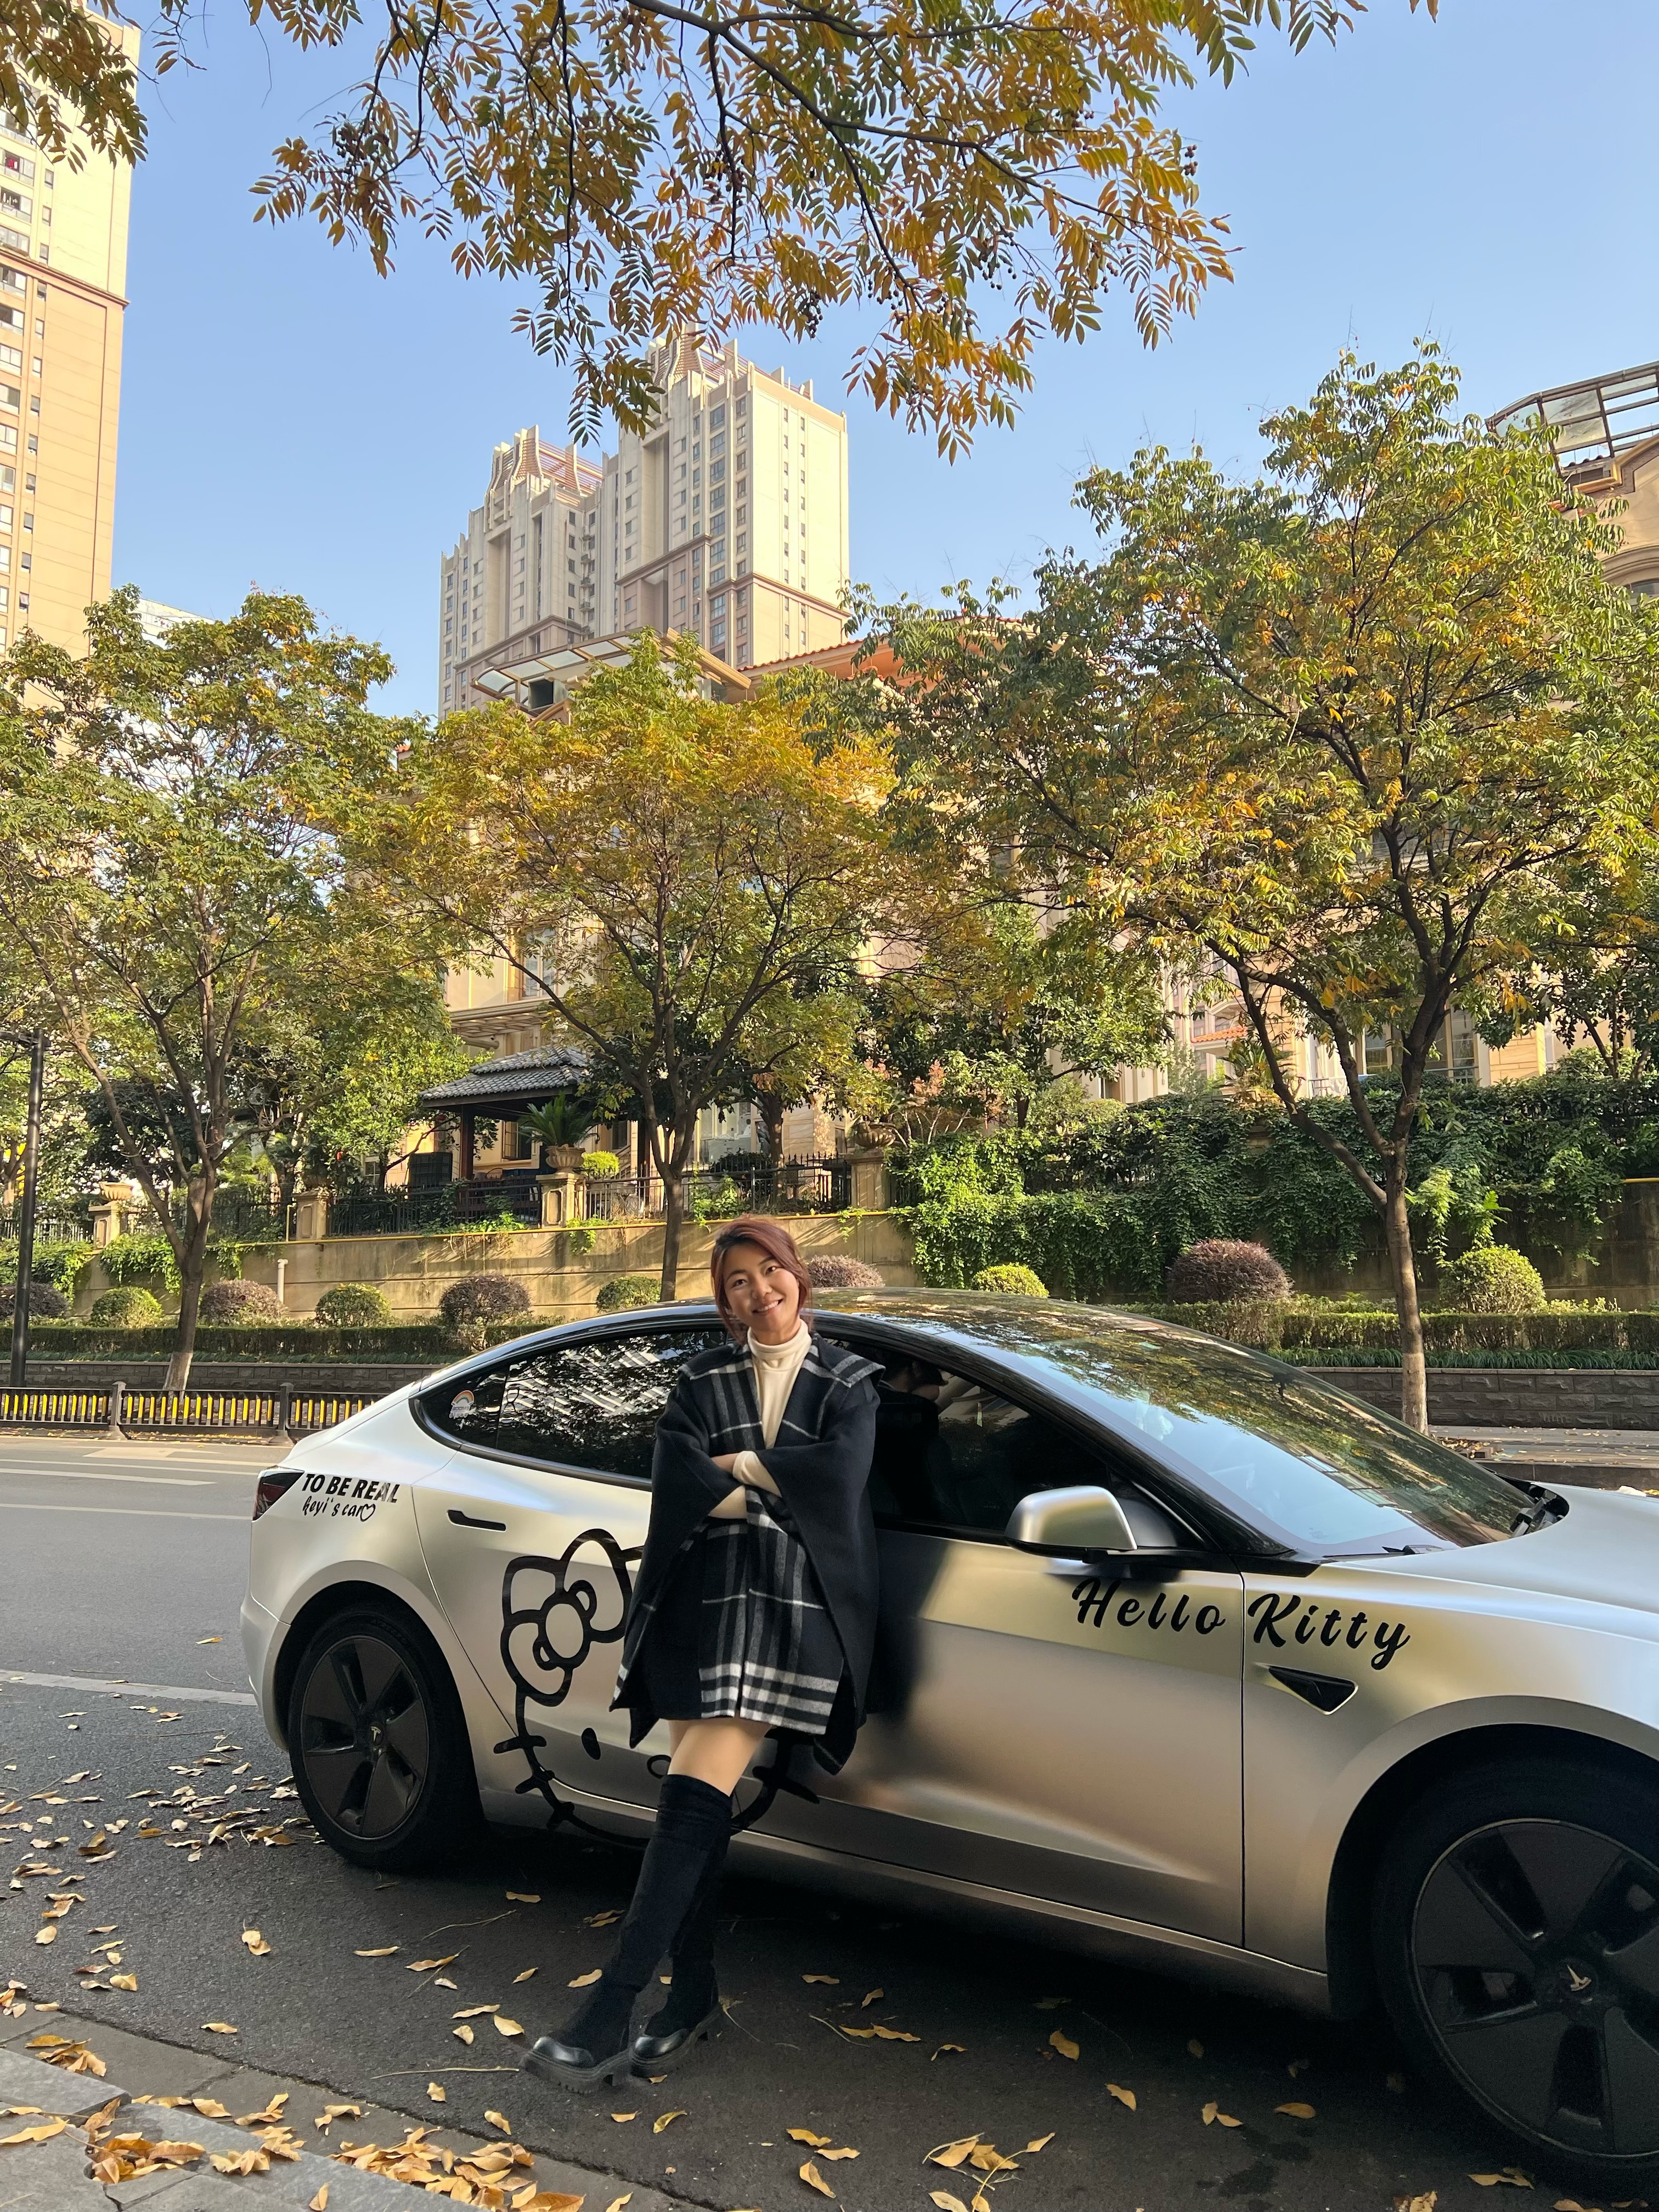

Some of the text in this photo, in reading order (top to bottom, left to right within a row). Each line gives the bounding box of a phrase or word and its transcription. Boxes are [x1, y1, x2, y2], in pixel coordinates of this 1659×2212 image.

[302, 1474, 400, 1503] TO BE REAL
[1071, 1577, 1412, 1671] Hello Kitty
